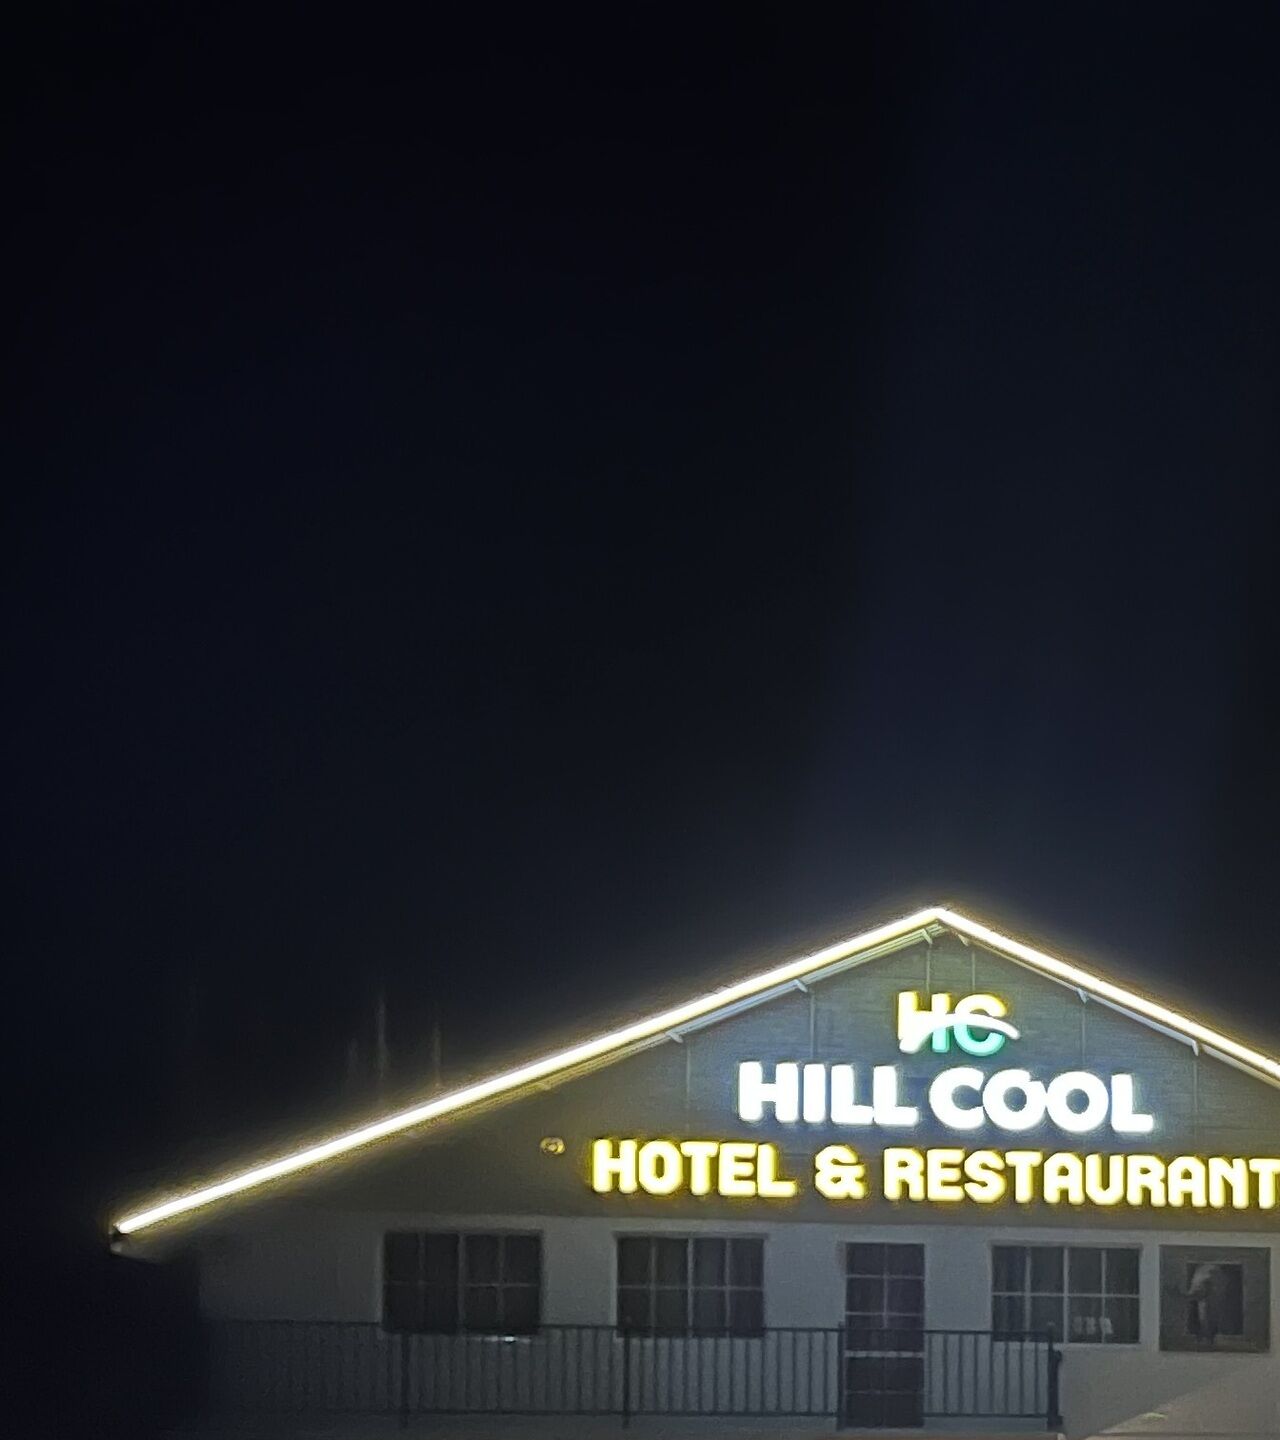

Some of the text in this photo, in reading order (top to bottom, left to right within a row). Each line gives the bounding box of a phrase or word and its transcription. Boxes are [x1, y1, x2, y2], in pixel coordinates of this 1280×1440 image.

[738, 1060, 1155, 1135] HILL COOL
[592, 1138, 796, 1199] HOTEL
[814, 1143, 865, 1201] &
